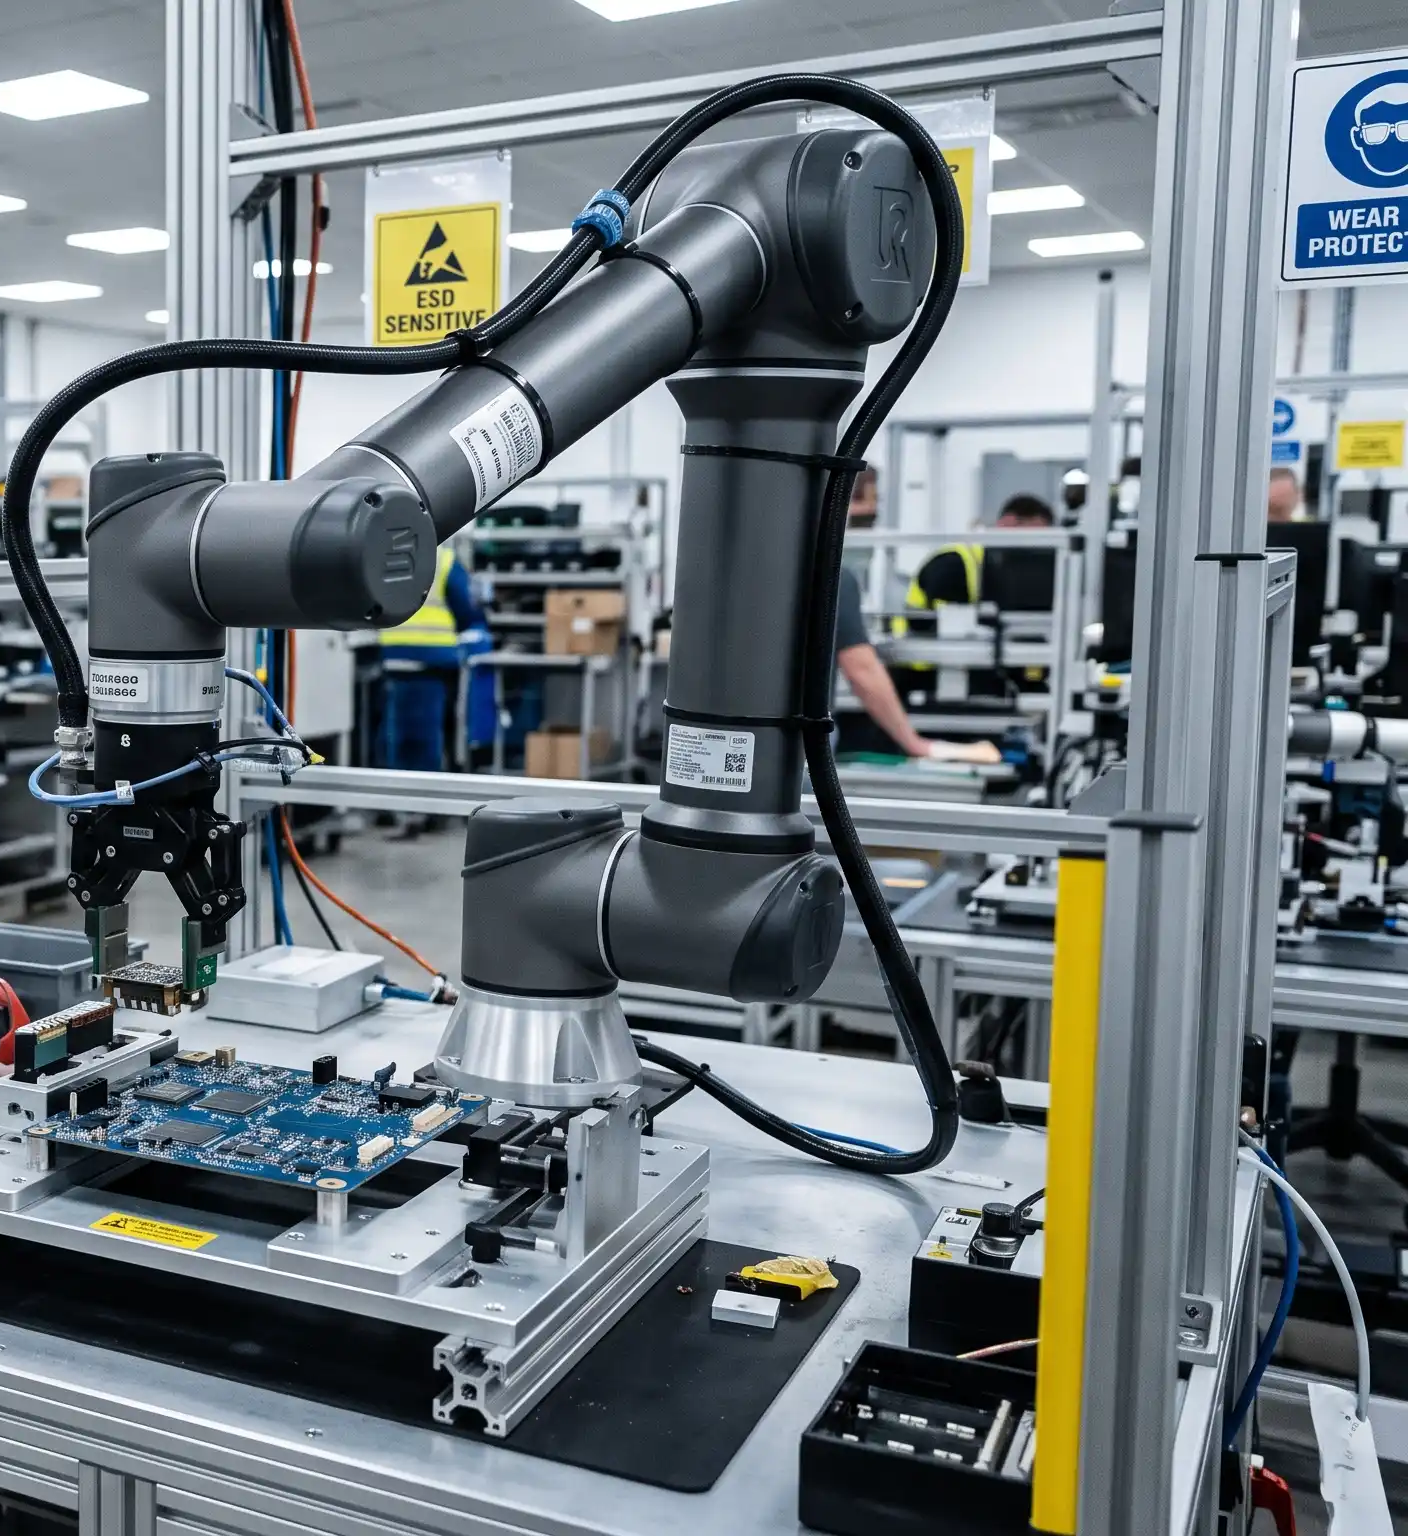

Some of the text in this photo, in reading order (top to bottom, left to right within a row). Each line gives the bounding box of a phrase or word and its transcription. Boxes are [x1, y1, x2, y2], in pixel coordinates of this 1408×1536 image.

[1328, 206, 1400, 231] WEAR
[1308, 231, 1408, 259] PROTEC
[416, 289, 455, 309] ESD
[385, 309, 486, 334] SENSITIVE
